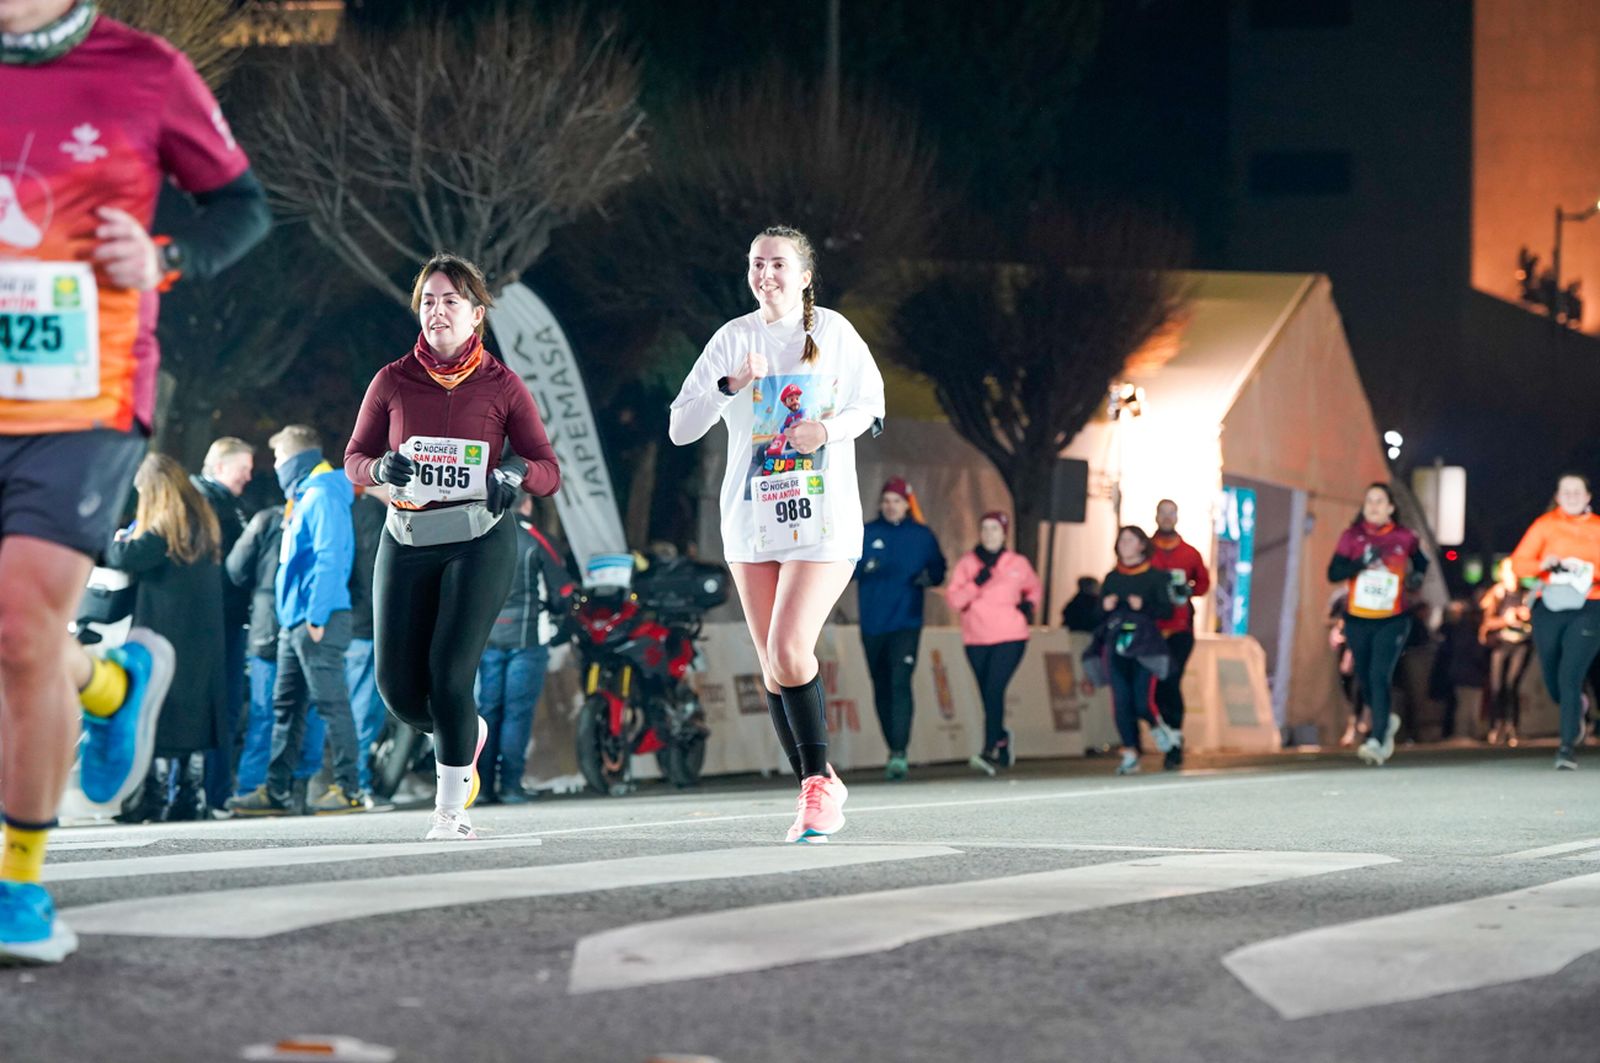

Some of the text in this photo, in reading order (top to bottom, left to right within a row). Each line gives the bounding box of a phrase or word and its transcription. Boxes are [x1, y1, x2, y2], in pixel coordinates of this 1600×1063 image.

[535, 325, 607, 498] JAPEMASA
[423, 445, 448, 454] NOCHE
[449, 447, 458, 455] DE
[414, 453, 430, 462] SAN
[763, 458, 813, 471] SUPER
[790, 479, 799, 487] DE
[761, 492, 778, 502] SAN
[775, 498, 812, 523] 988
